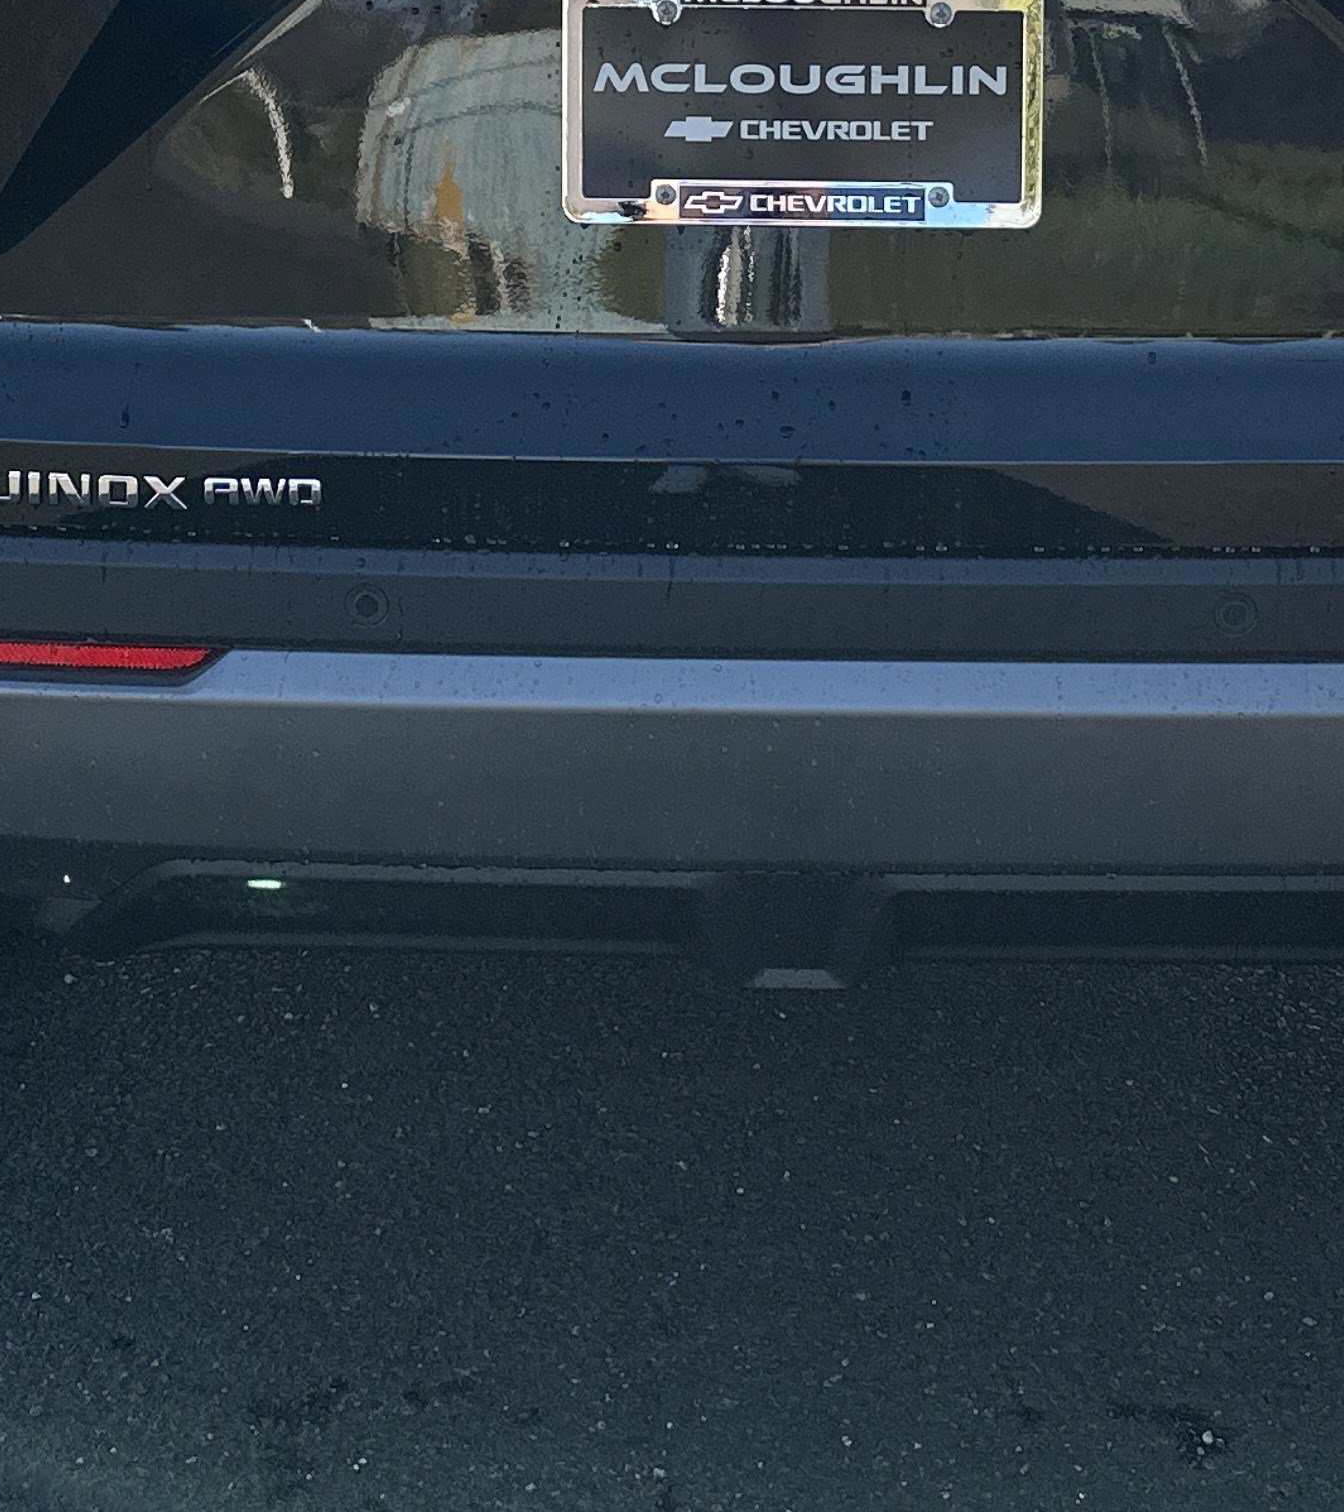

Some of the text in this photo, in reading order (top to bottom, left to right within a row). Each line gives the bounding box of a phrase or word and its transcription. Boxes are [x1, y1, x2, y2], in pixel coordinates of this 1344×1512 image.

[593, 62, 1008, 96] MCLOUGHLIN
[739, 119, 934, 141] CHEVROLET
[749, 193, 922, 214] CHEVROLET
[203, 477, 322, 506] AWD
